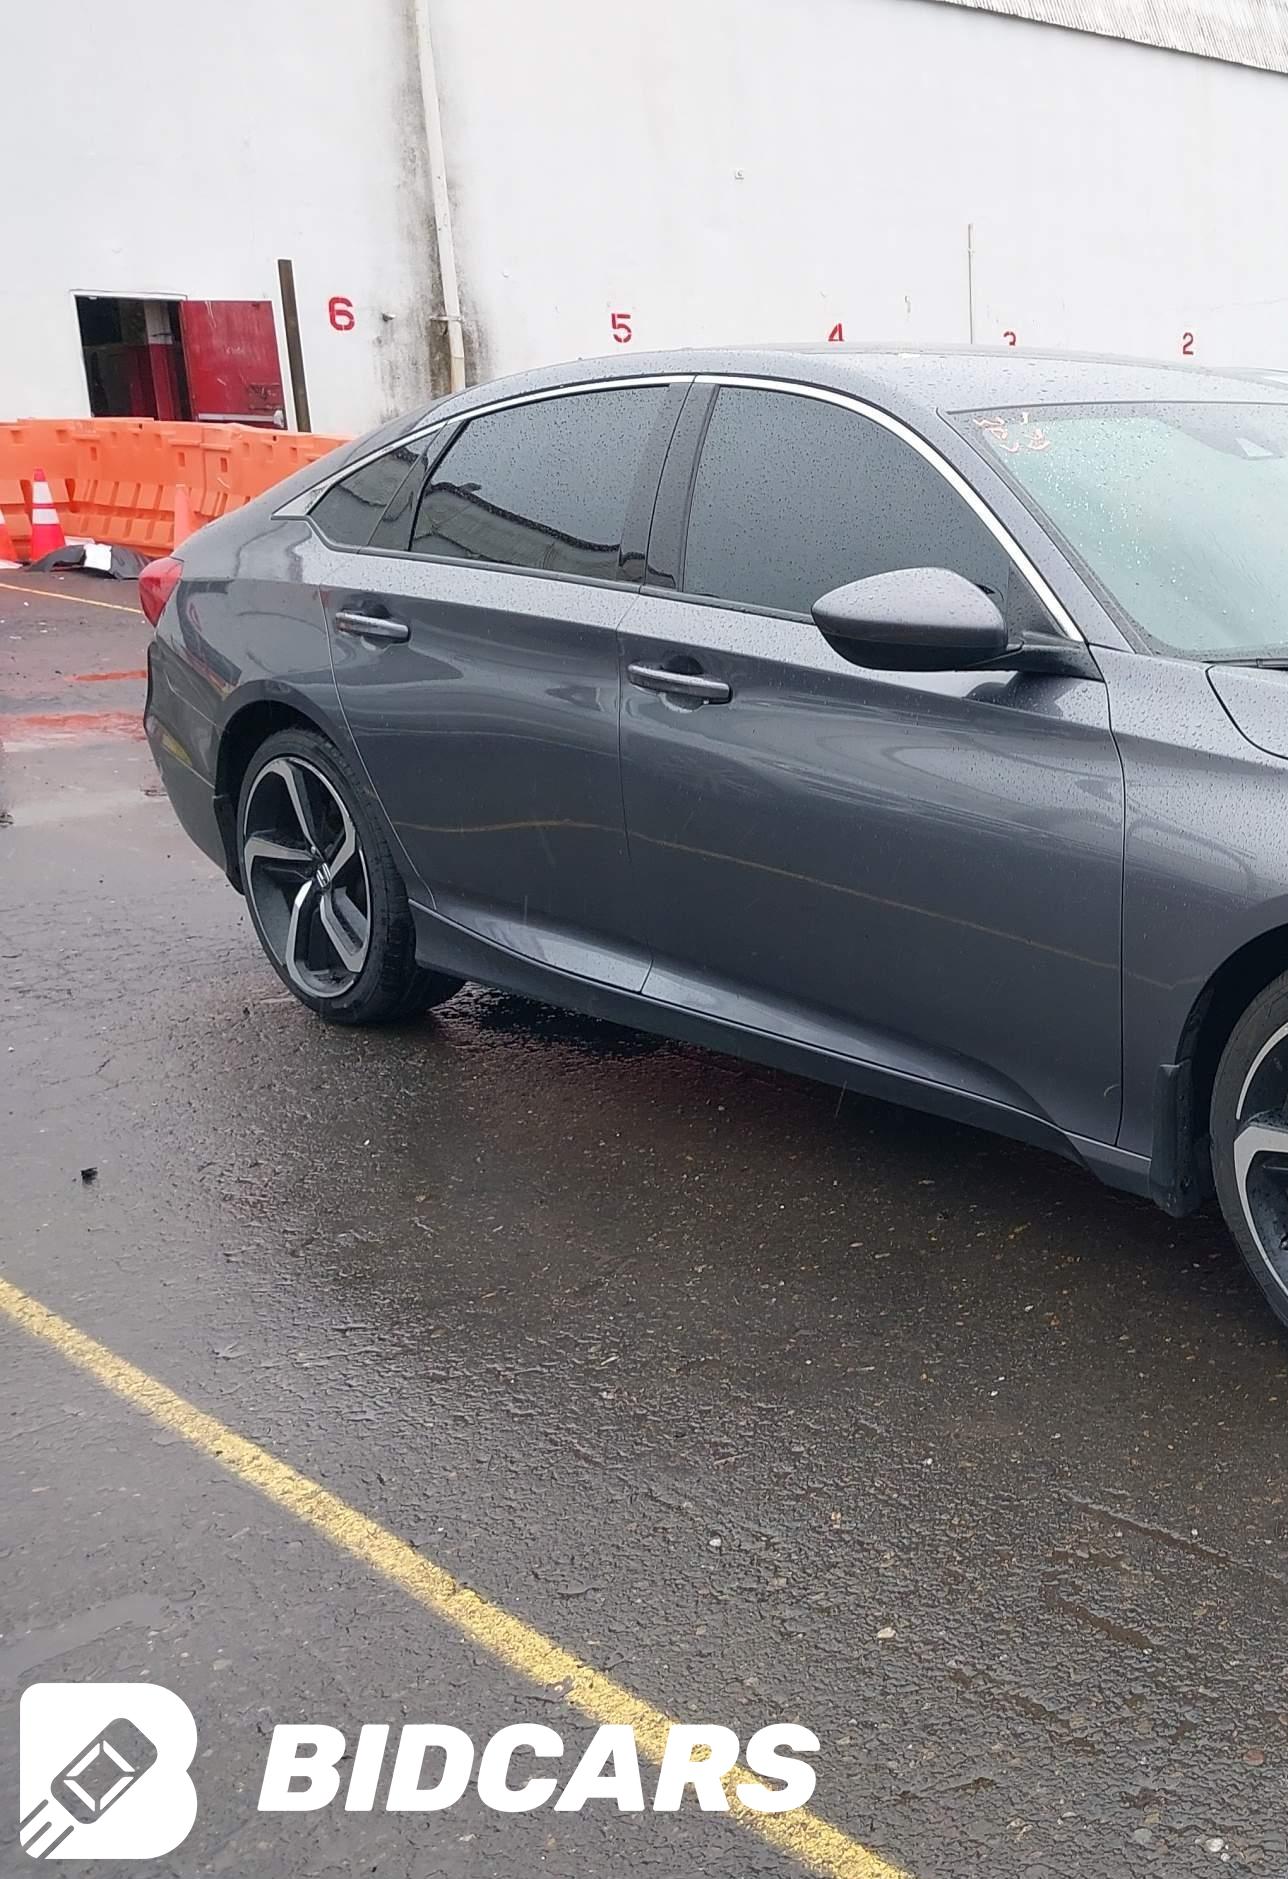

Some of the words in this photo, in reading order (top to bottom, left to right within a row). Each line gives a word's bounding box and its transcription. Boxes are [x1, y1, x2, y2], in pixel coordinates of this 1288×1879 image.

[329, 297, 355, 331] 6
[611, 313, 632, 343] 5
[828, 323, 845, 342] 4
[1182, 332, 1194, 355] 2
